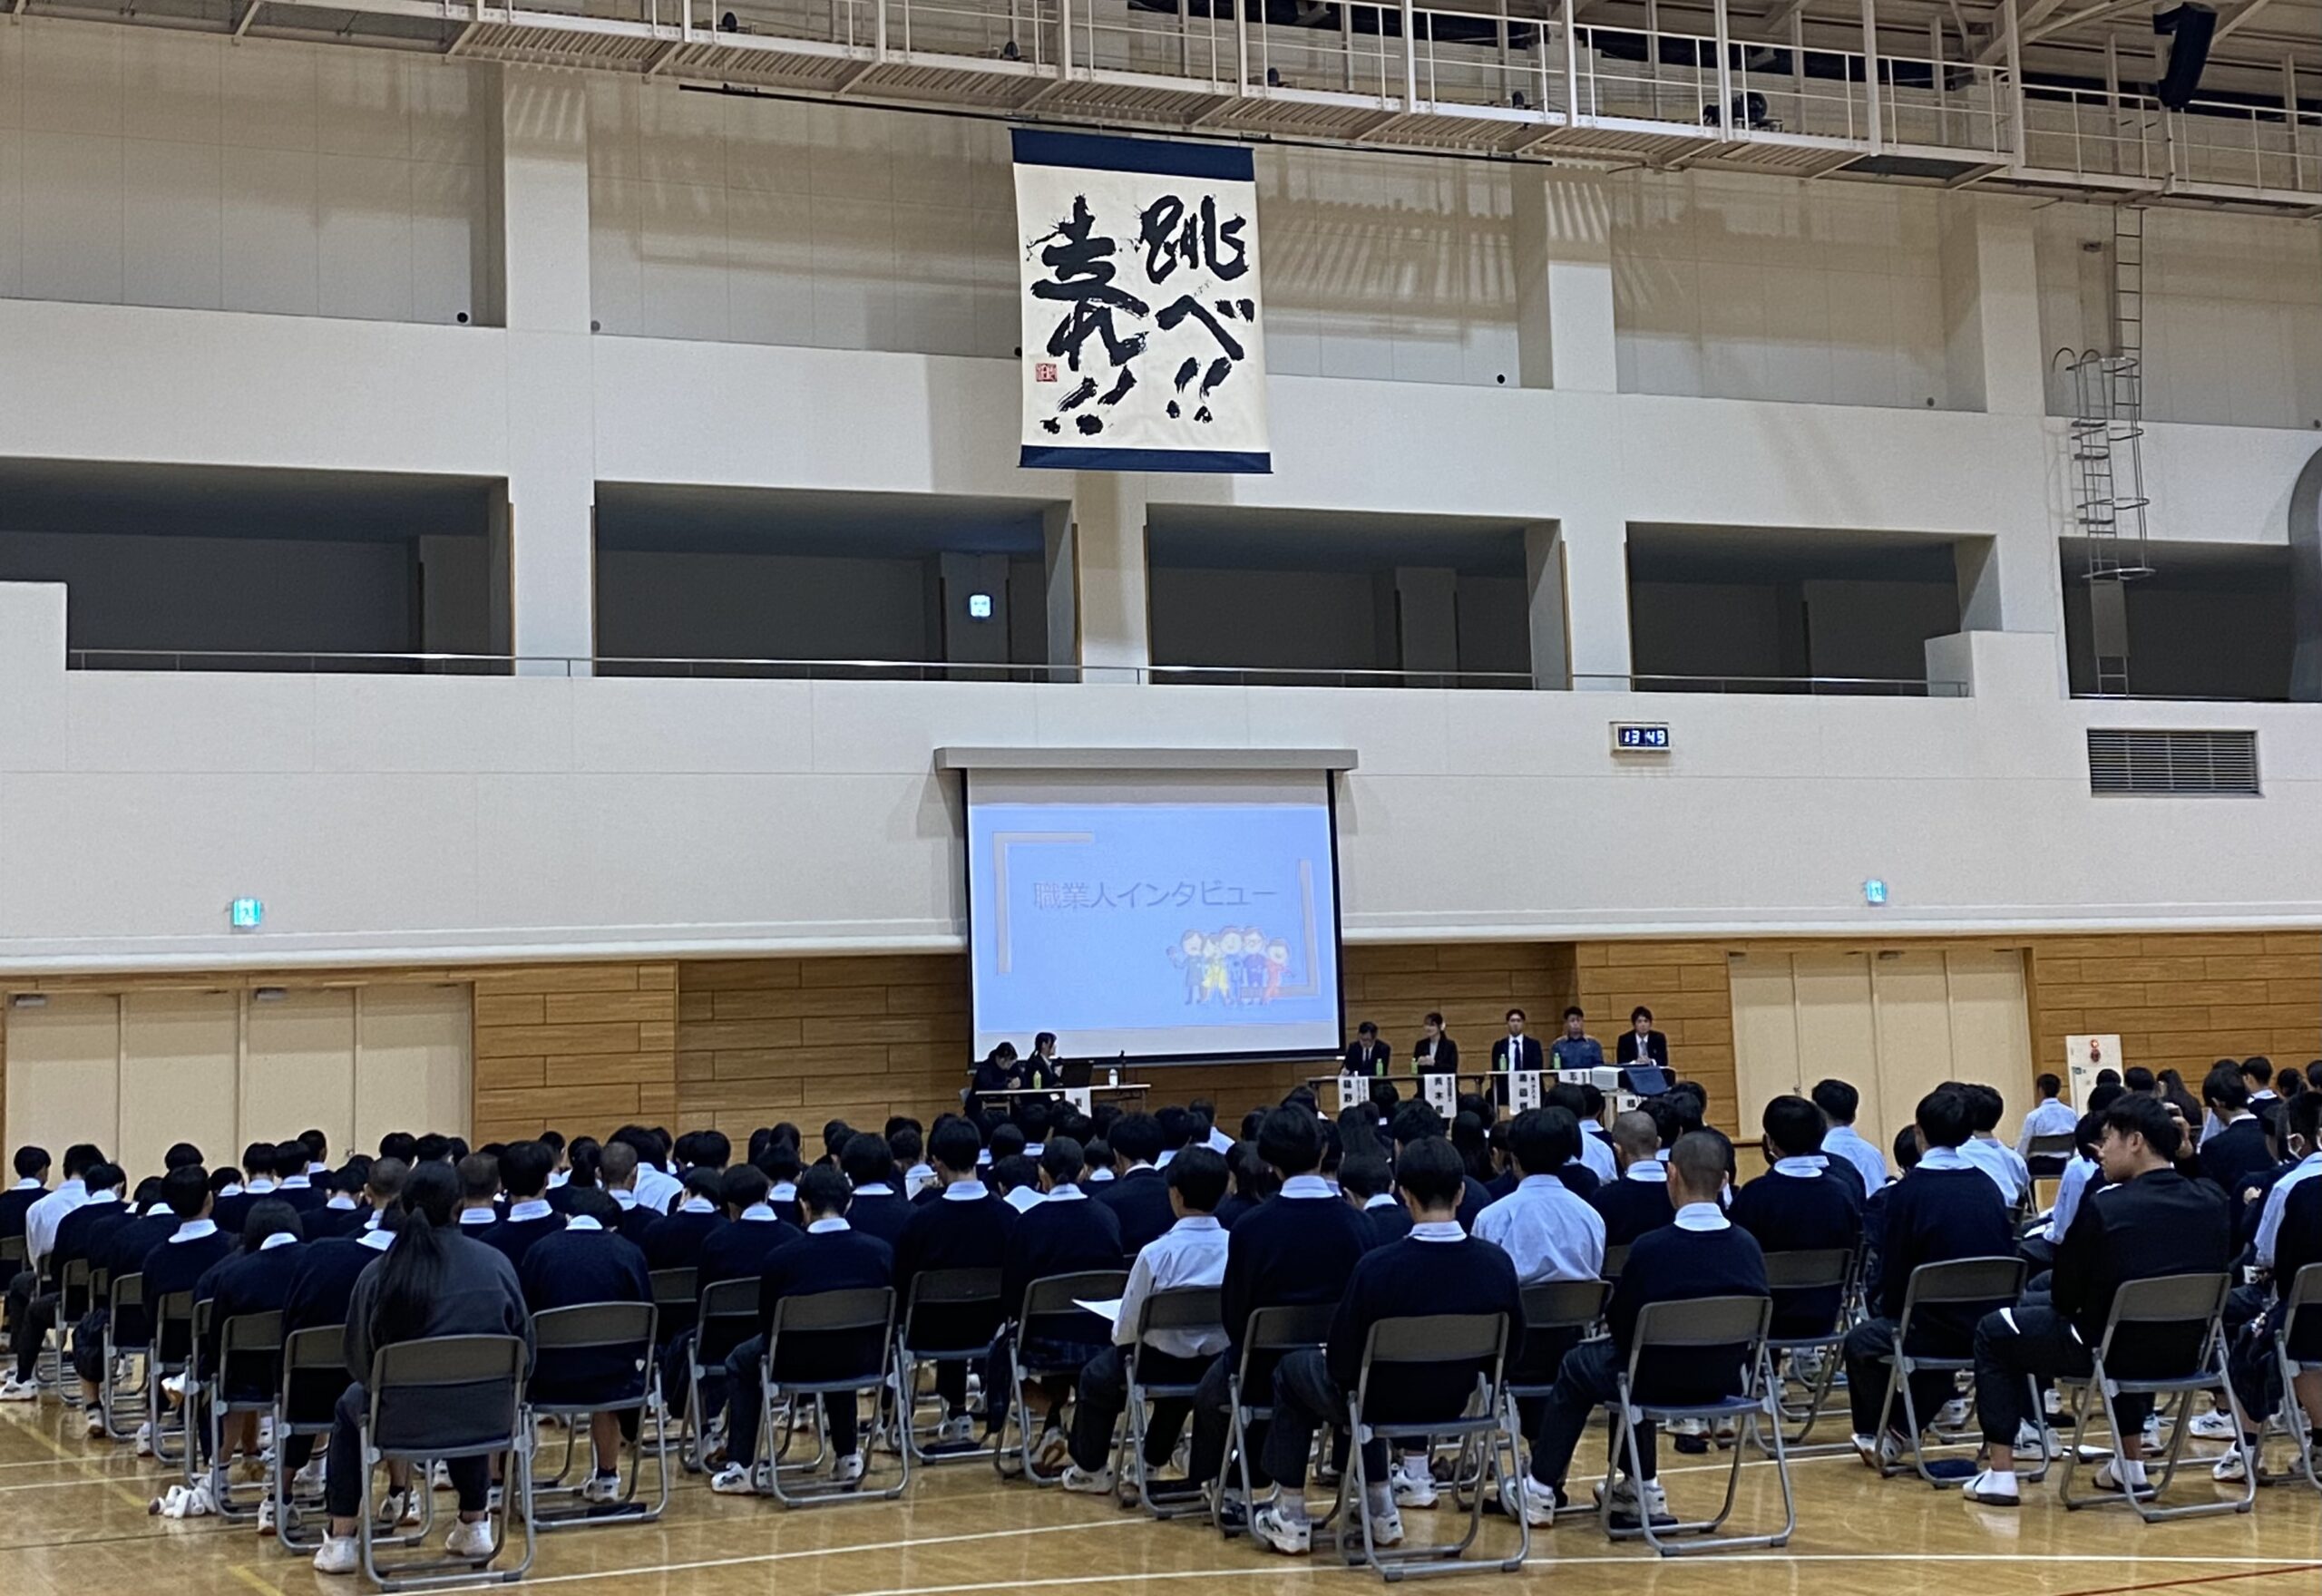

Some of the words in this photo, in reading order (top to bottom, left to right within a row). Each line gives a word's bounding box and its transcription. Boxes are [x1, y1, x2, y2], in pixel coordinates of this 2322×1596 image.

[1033, 881, 1277, 909] 職業人インタビュー
